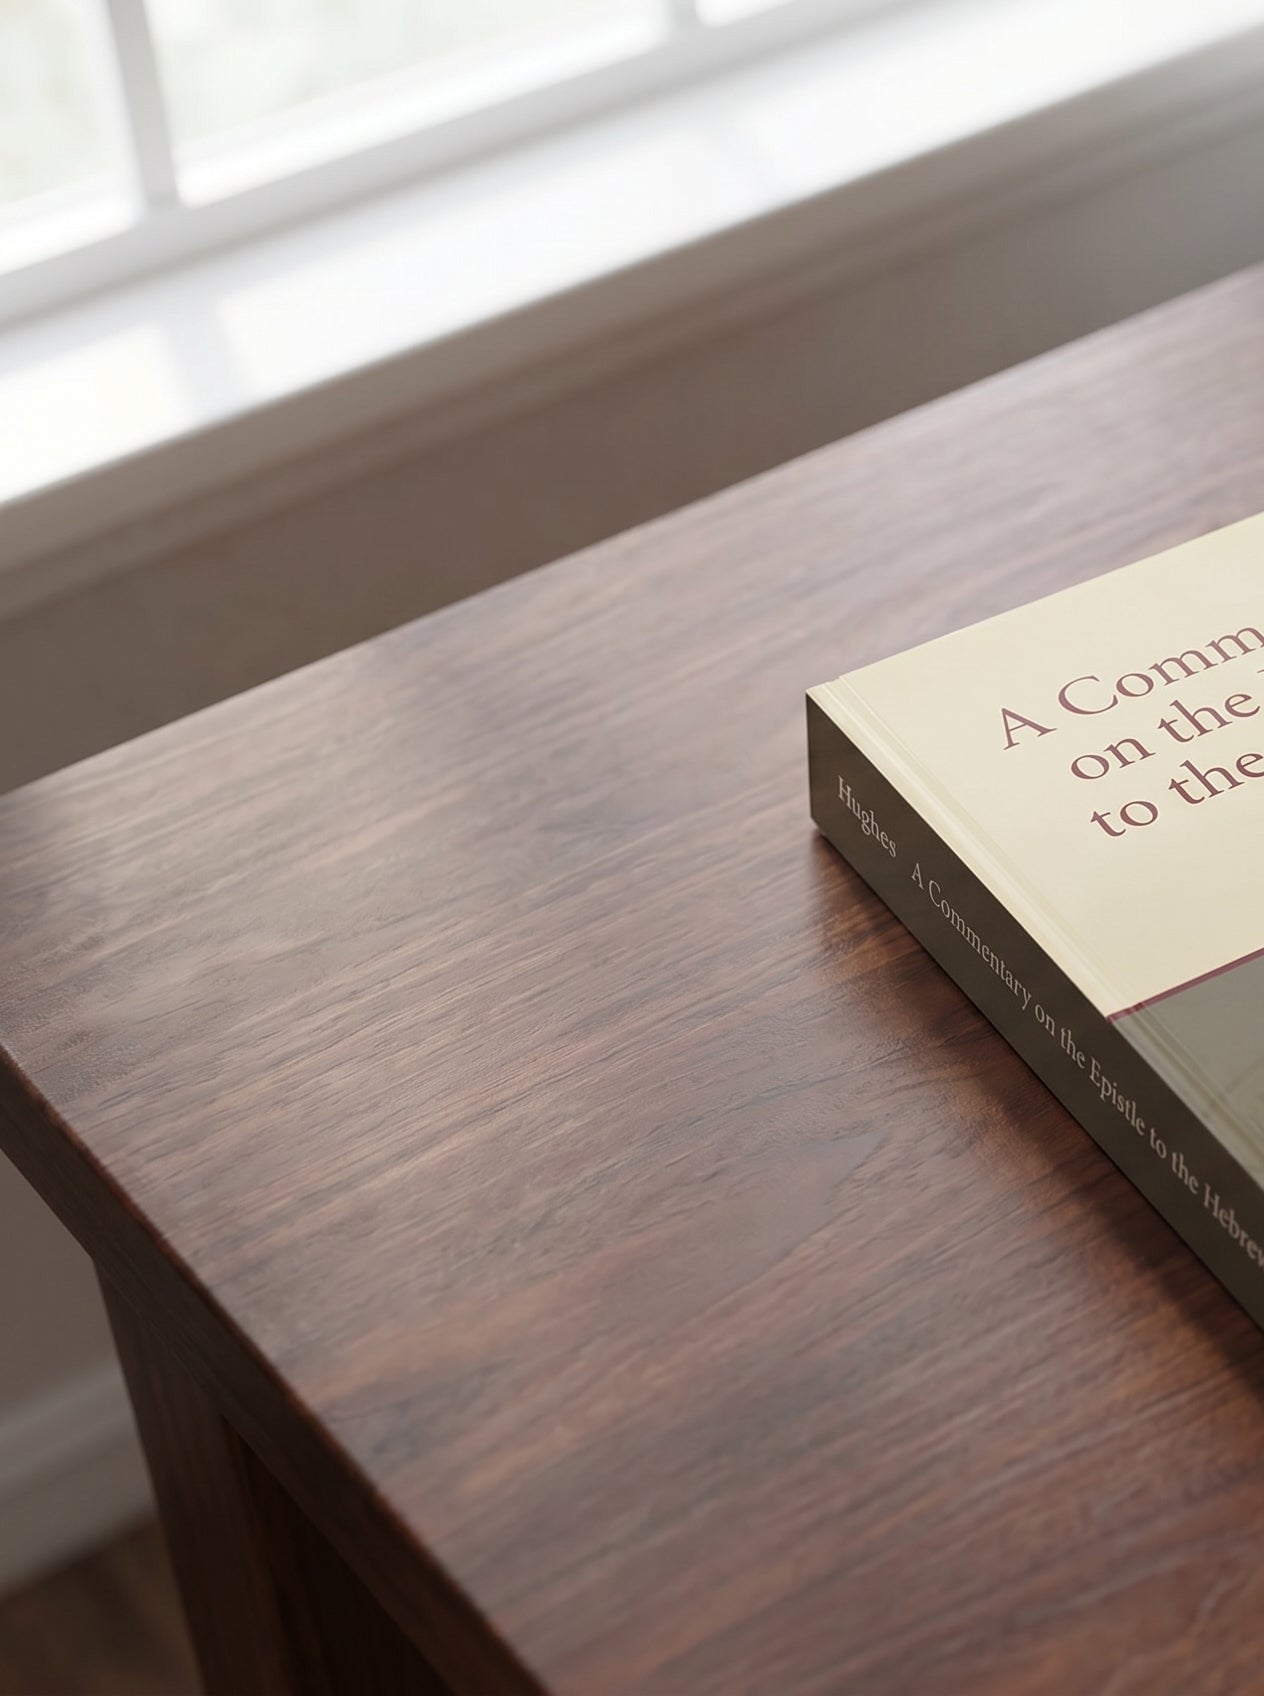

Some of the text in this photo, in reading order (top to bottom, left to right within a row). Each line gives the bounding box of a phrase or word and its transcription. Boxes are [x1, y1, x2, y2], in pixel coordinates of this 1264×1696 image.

[1000, 707, 1056, 749] A
[1070, 736, 1156, 779] on
[1157, 692, 1261, 744] the
[1090, 798, 1159, 837] to
[837, 775, 897, 858] Hughes
[911, 862, 924, 890] A
[928, 880, 1032, 1011] Commentary
[1034, 1003, 1056, 1037] on
[1060, 1027, 1086, 1069] the
[1089, 1056, 1146, 1137] Epistle
[1150, 1127, 1167, 1159] to
[1172, 1152, 1199, 1194] the
